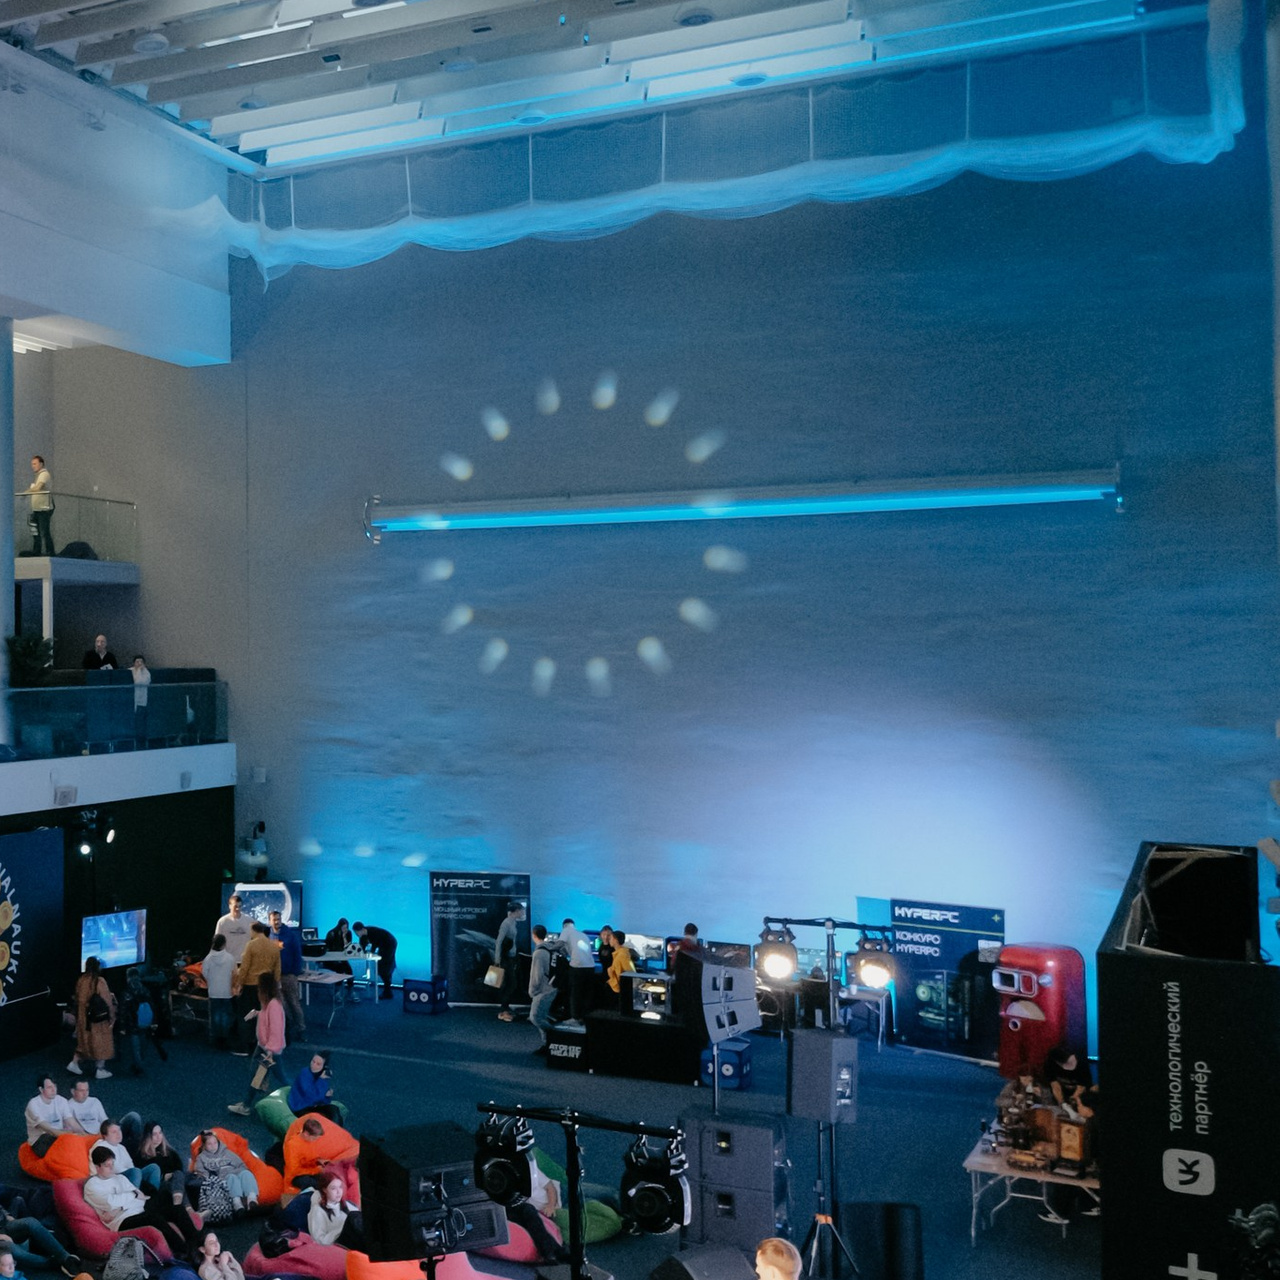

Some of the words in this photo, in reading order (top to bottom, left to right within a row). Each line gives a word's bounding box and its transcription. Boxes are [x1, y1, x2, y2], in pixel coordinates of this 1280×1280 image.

[433, 878, 491, 889] HYPERPC
[894, 906, 960, 923] HYPERPC
[1163, 982, 1183, 1131] технологический
[1190, 1061, 1213, 1135] партнёр
